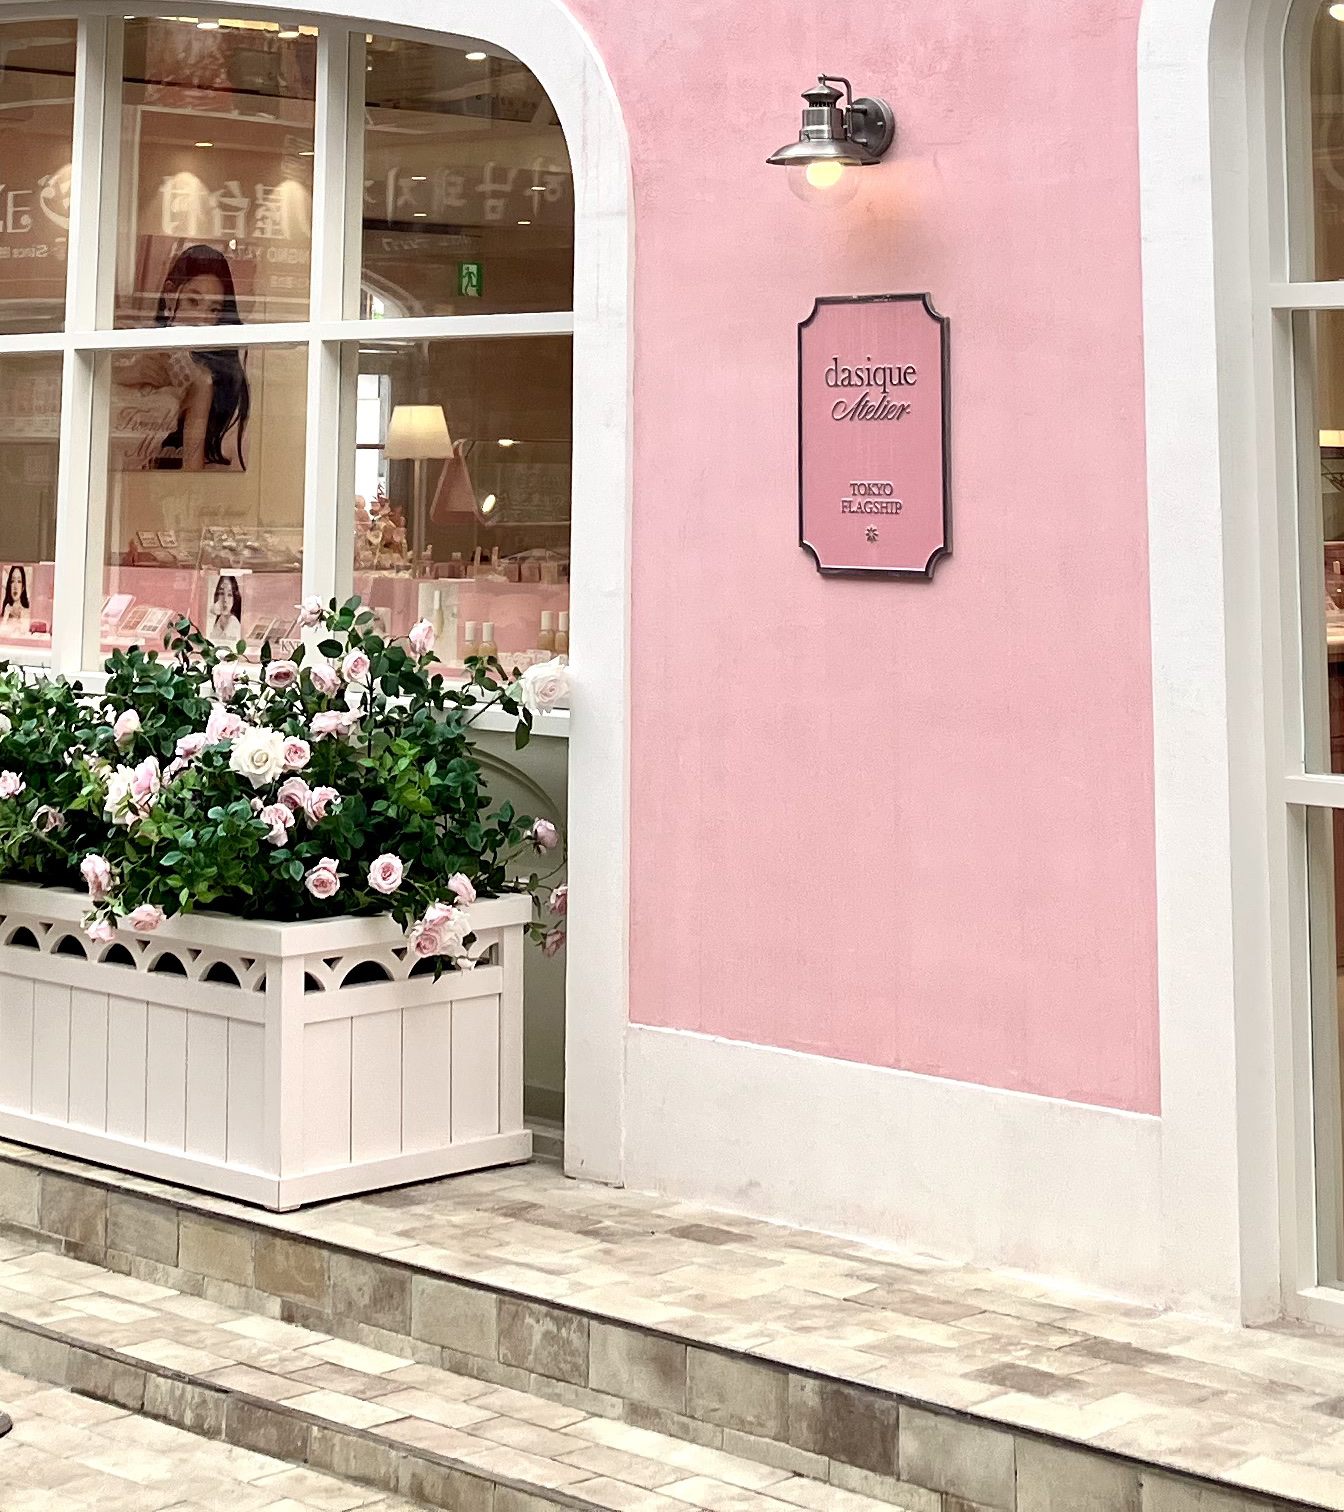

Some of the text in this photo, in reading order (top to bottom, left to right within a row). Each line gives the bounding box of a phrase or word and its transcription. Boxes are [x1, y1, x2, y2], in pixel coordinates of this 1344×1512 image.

[824, 355, 918, 394] dasique
[831, 391, 911, 421] Atelier
[849, 481, 894, 497] TOKYO
[841, 499, 903, 515] FLAGSHIP
